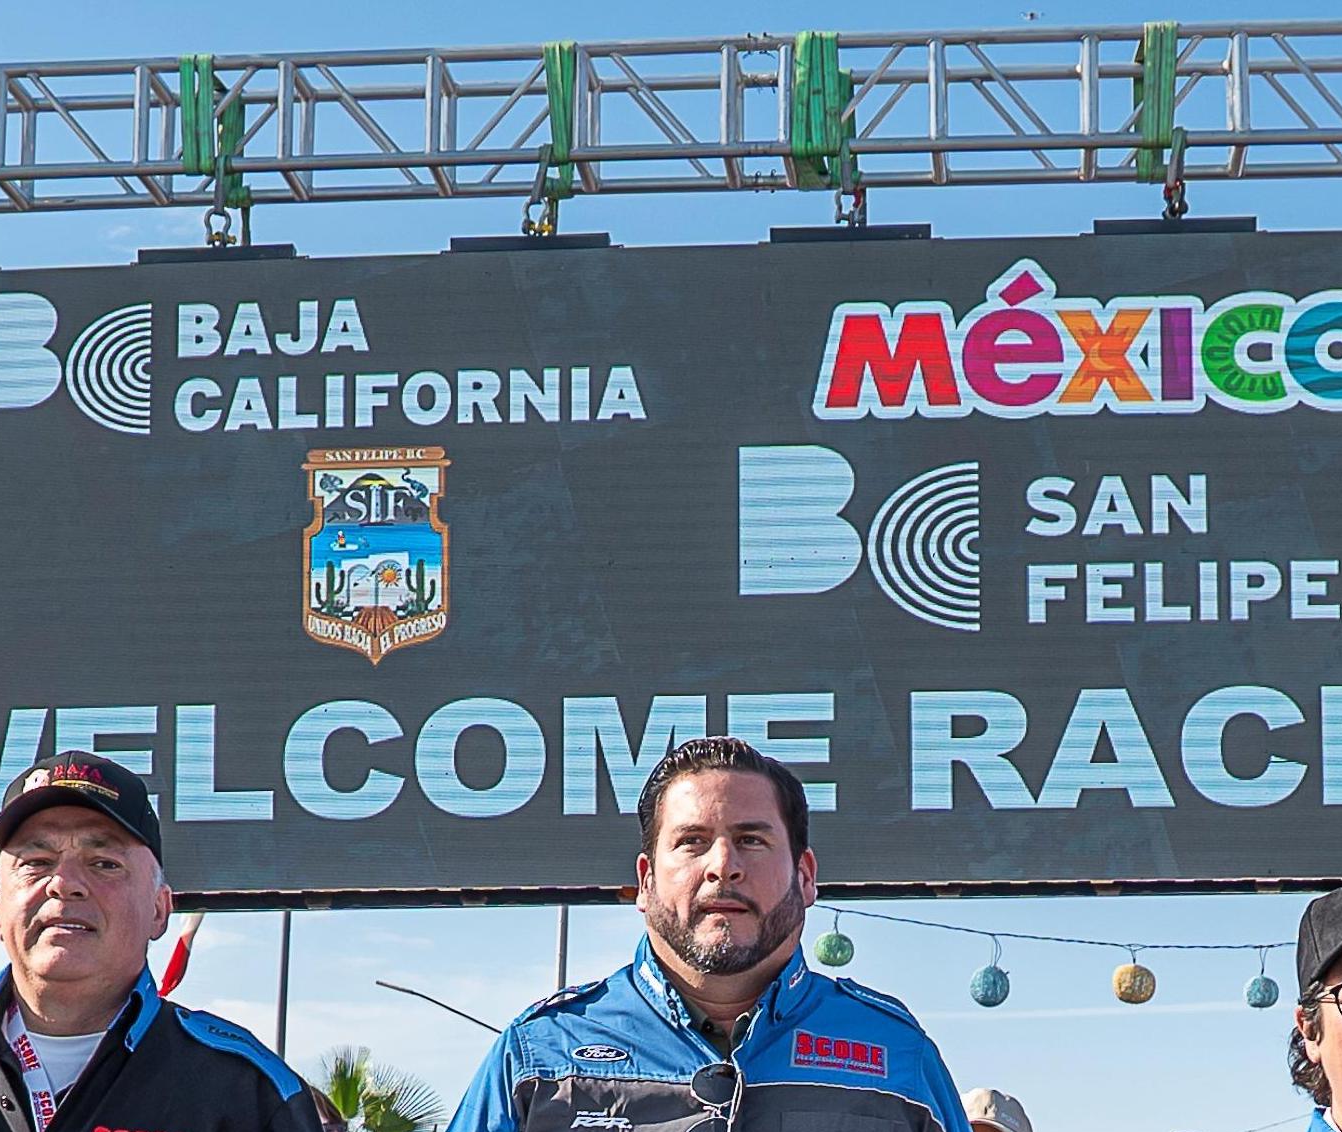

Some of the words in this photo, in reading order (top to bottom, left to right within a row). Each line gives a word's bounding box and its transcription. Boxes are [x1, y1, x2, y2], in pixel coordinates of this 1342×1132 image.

[177, 298, 369, 358] BAJA
[173, 365, 647, 434] CALIFORNIA
[325, 450, 355, 461] SAN
[1025, 474, 1207, 537] SAN
[1028, 560, 1341, 624] FELIPE
[18, 1033, 41, 1070] SCORE
[796, 1033, 883, 1066] SCORE
